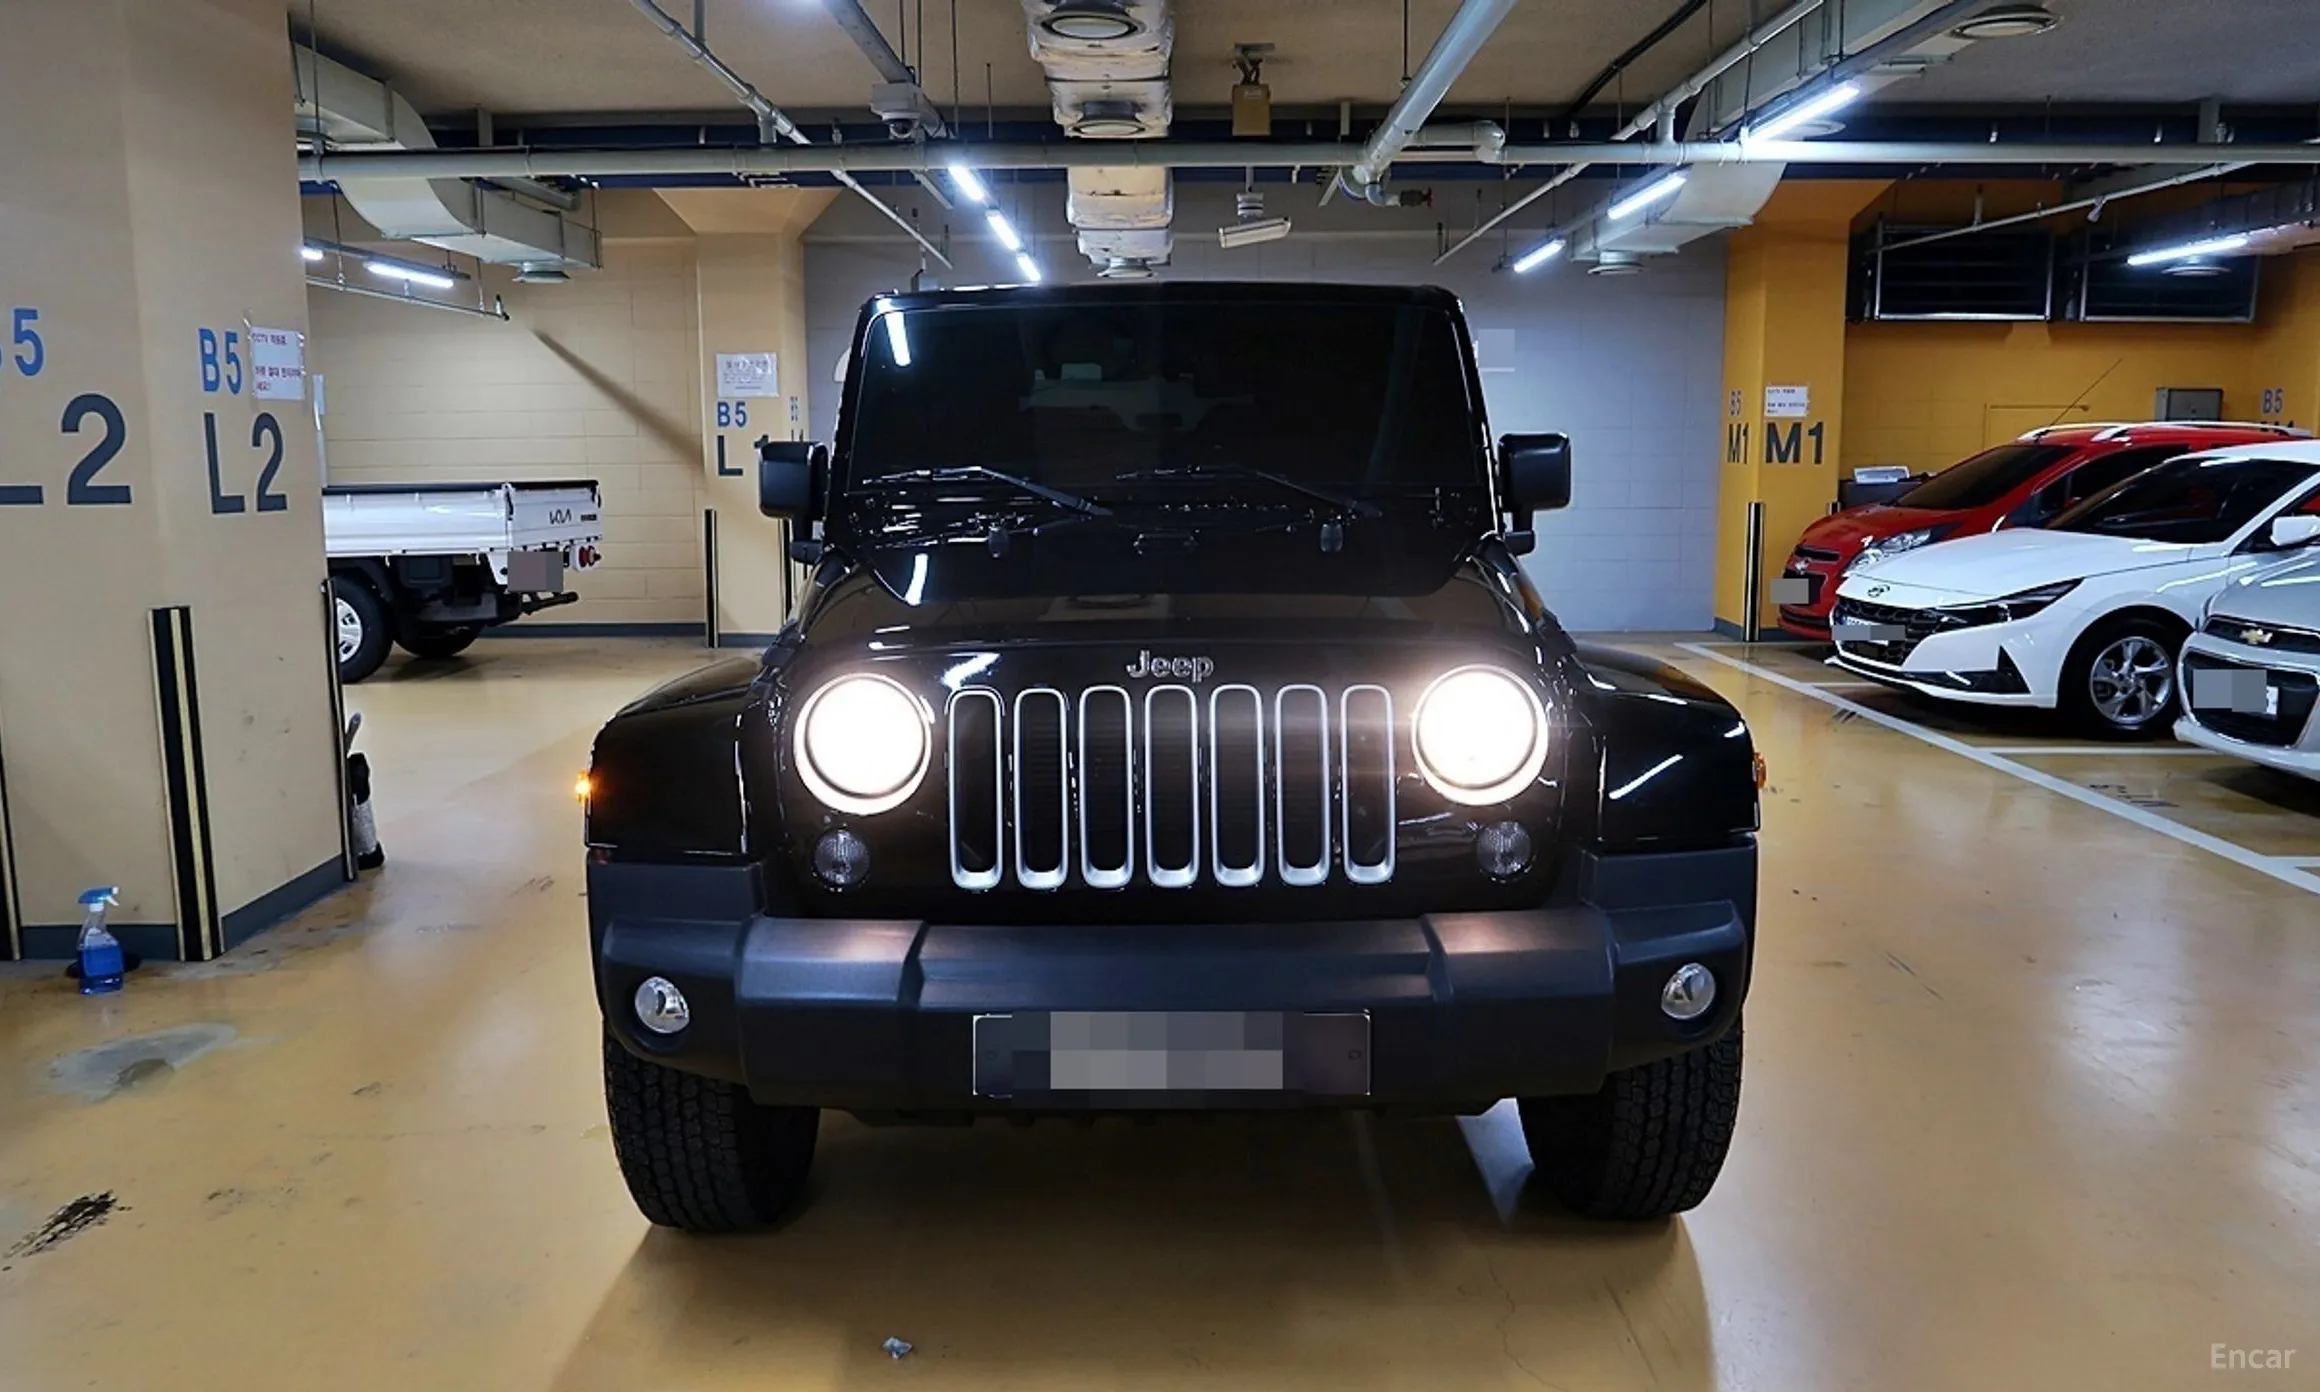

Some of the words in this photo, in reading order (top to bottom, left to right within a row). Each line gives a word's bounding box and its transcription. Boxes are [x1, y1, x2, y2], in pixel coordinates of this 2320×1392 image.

[0, 308, 44, 377] 5
[198, 328, 242, 395] B5
[717, 401, 747, 427] B5
[204, 412, 288, 514] L2
[1765, 422, 1824, 464] M1
[1126, 650, 1214, 682] Jeep
